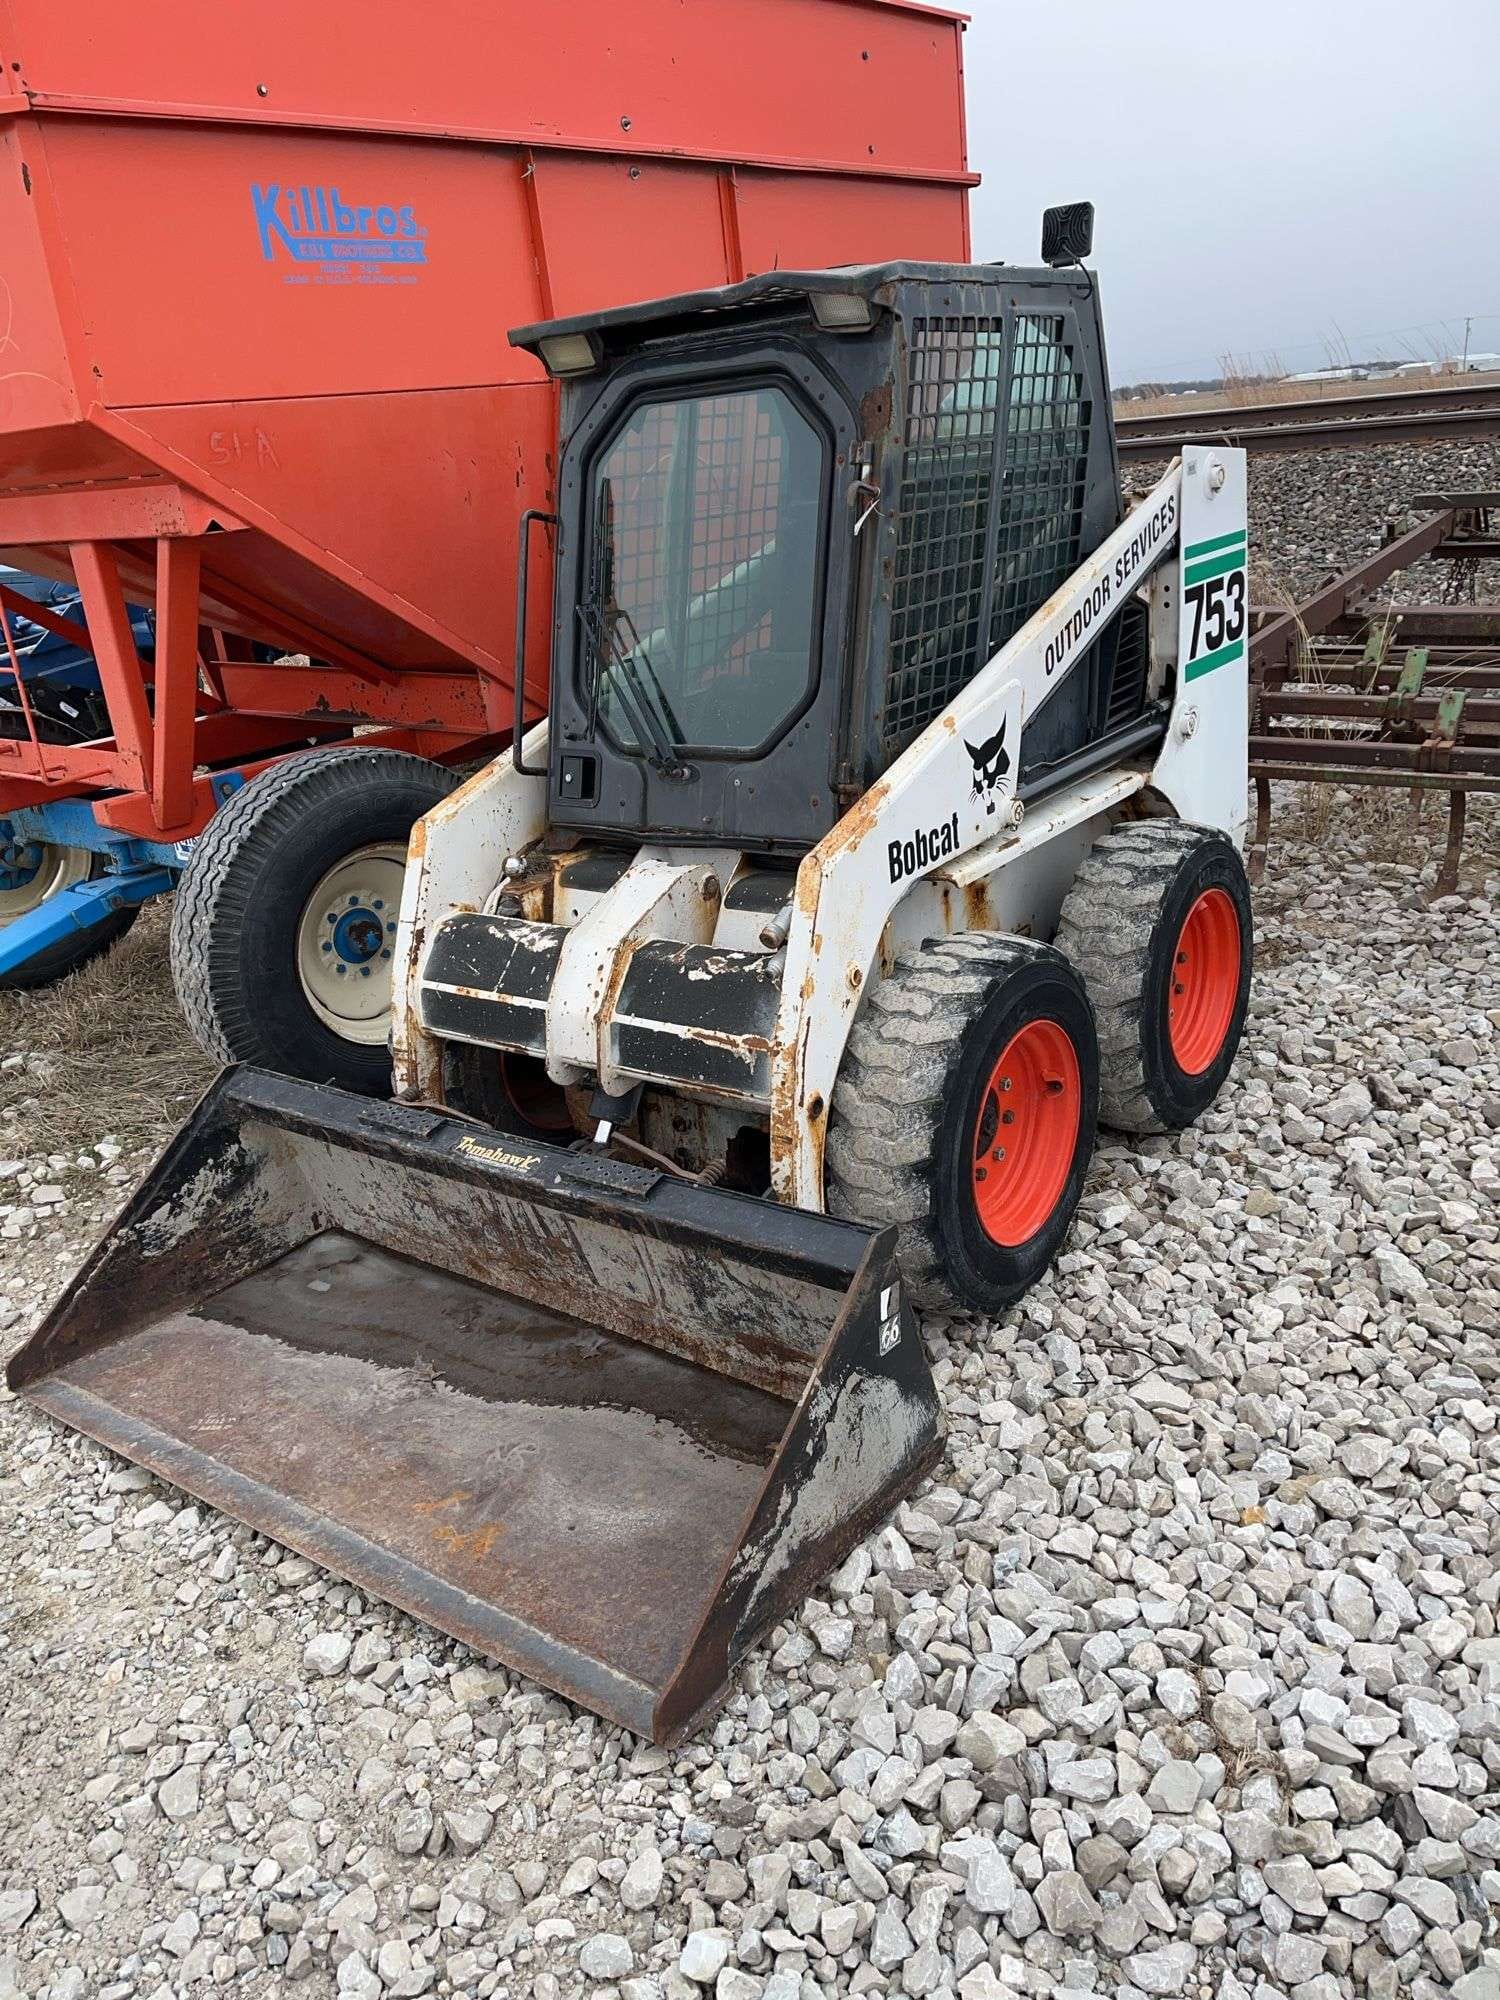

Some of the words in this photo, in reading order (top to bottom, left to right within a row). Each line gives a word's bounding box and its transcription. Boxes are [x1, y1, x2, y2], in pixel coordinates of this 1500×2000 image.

[250, 184, 417, 261] Killbros
[1045, 574, 1111, 676] OUTDOOR
[1115, 495, 1175, 589] SERVICES
[1185, 570, 1245, 661] 753
[888, 811, 959, 884] Bobcat
[456, 1136, 541, 1170] Tomahawk
